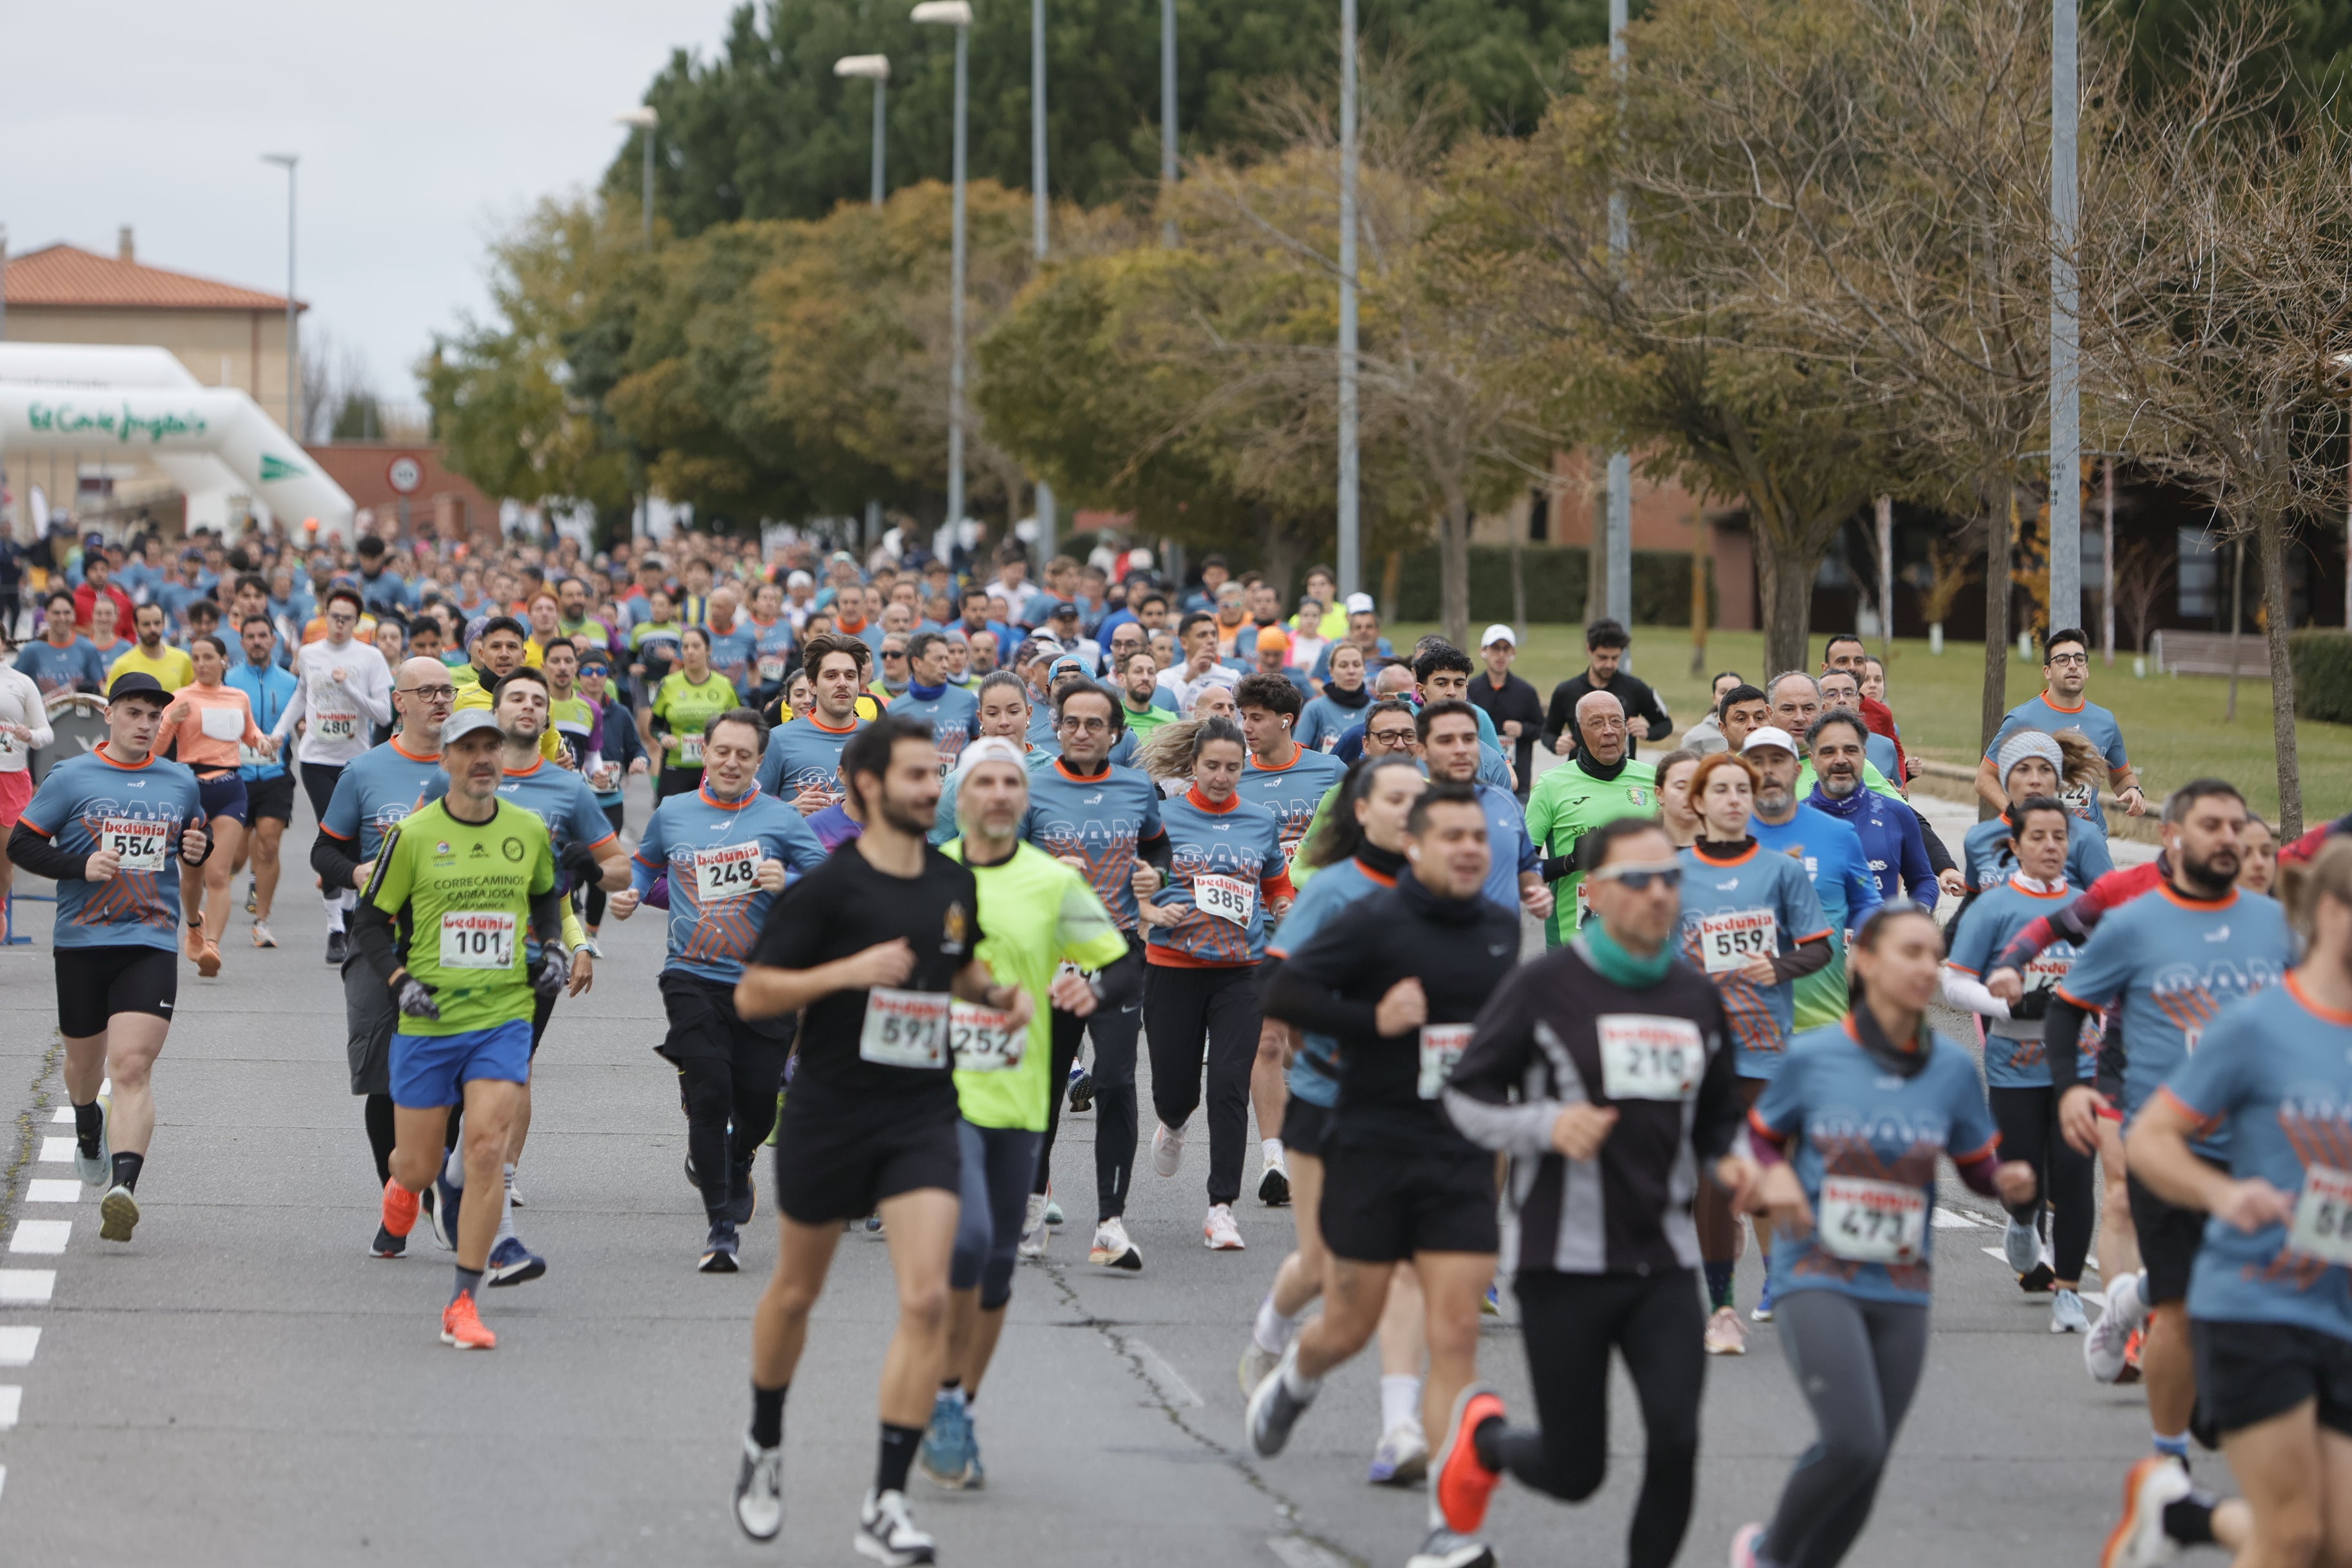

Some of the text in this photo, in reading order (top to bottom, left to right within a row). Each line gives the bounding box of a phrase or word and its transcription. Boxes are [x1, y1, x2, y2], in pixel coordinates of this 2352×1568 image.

[322, 720, 350, 733] 480
[104, 821, 166, 837] bedunia
[114, 835, 155, 857] 554
[696, 846, 759, 866] bedunia
[434, 876, 524, 890] CORRECAMINOS
[710, 860, 753, 888] 248
[447, 888, 514, 901] CARBAJOSA
[1196, 877, 1252, 897] bedunia
[1207, 888, 1244, 914] 385
[444, 916, 513, 930] bedunia
[1703, 914, 1772, 933] bedunia
[455, 931, 500, 955] 101
[1716, 929, 1763, 955] 559
[950, 1028, 1011, 1055] 252
